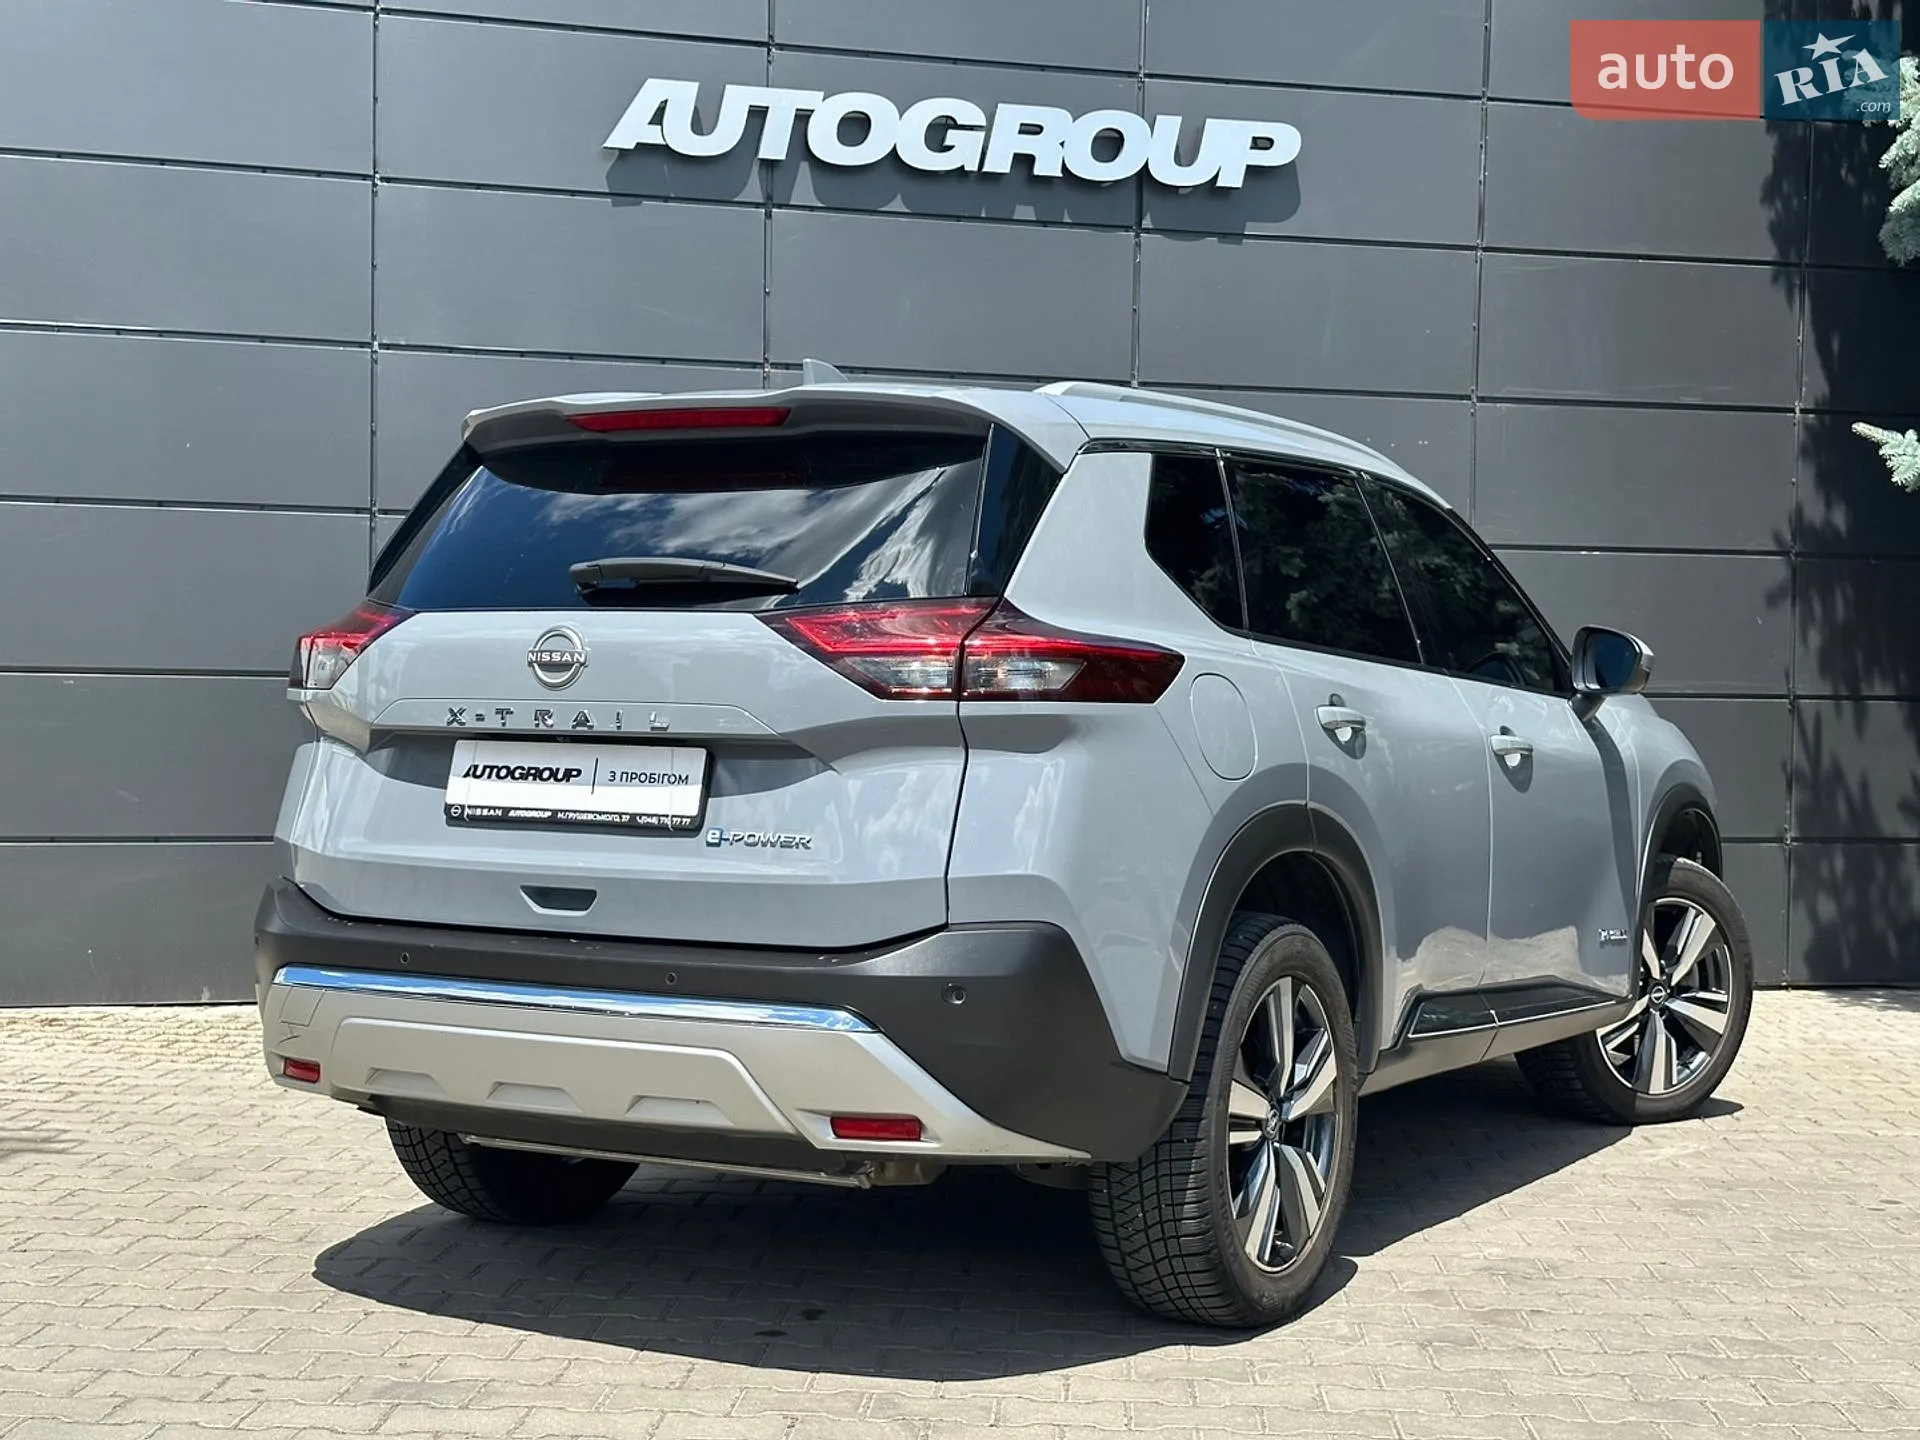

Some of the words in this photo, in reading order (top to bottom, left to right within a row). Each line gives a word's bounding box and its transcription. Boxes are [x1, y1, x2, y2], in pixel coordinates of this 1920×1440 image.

[601, 78, 1301, 189] AUTOGROUP
[528, 650, 586, 663] NISSAN
[446, 706, 671, 731] X-TRAIL
[462, 764, 582, 783] AUTOGROUP
[619, 771, 690, 785] ПРОБІГОМ
[466, 807, 503, 817] NISSAN
[706, 828, 813, 850] e-POWER
